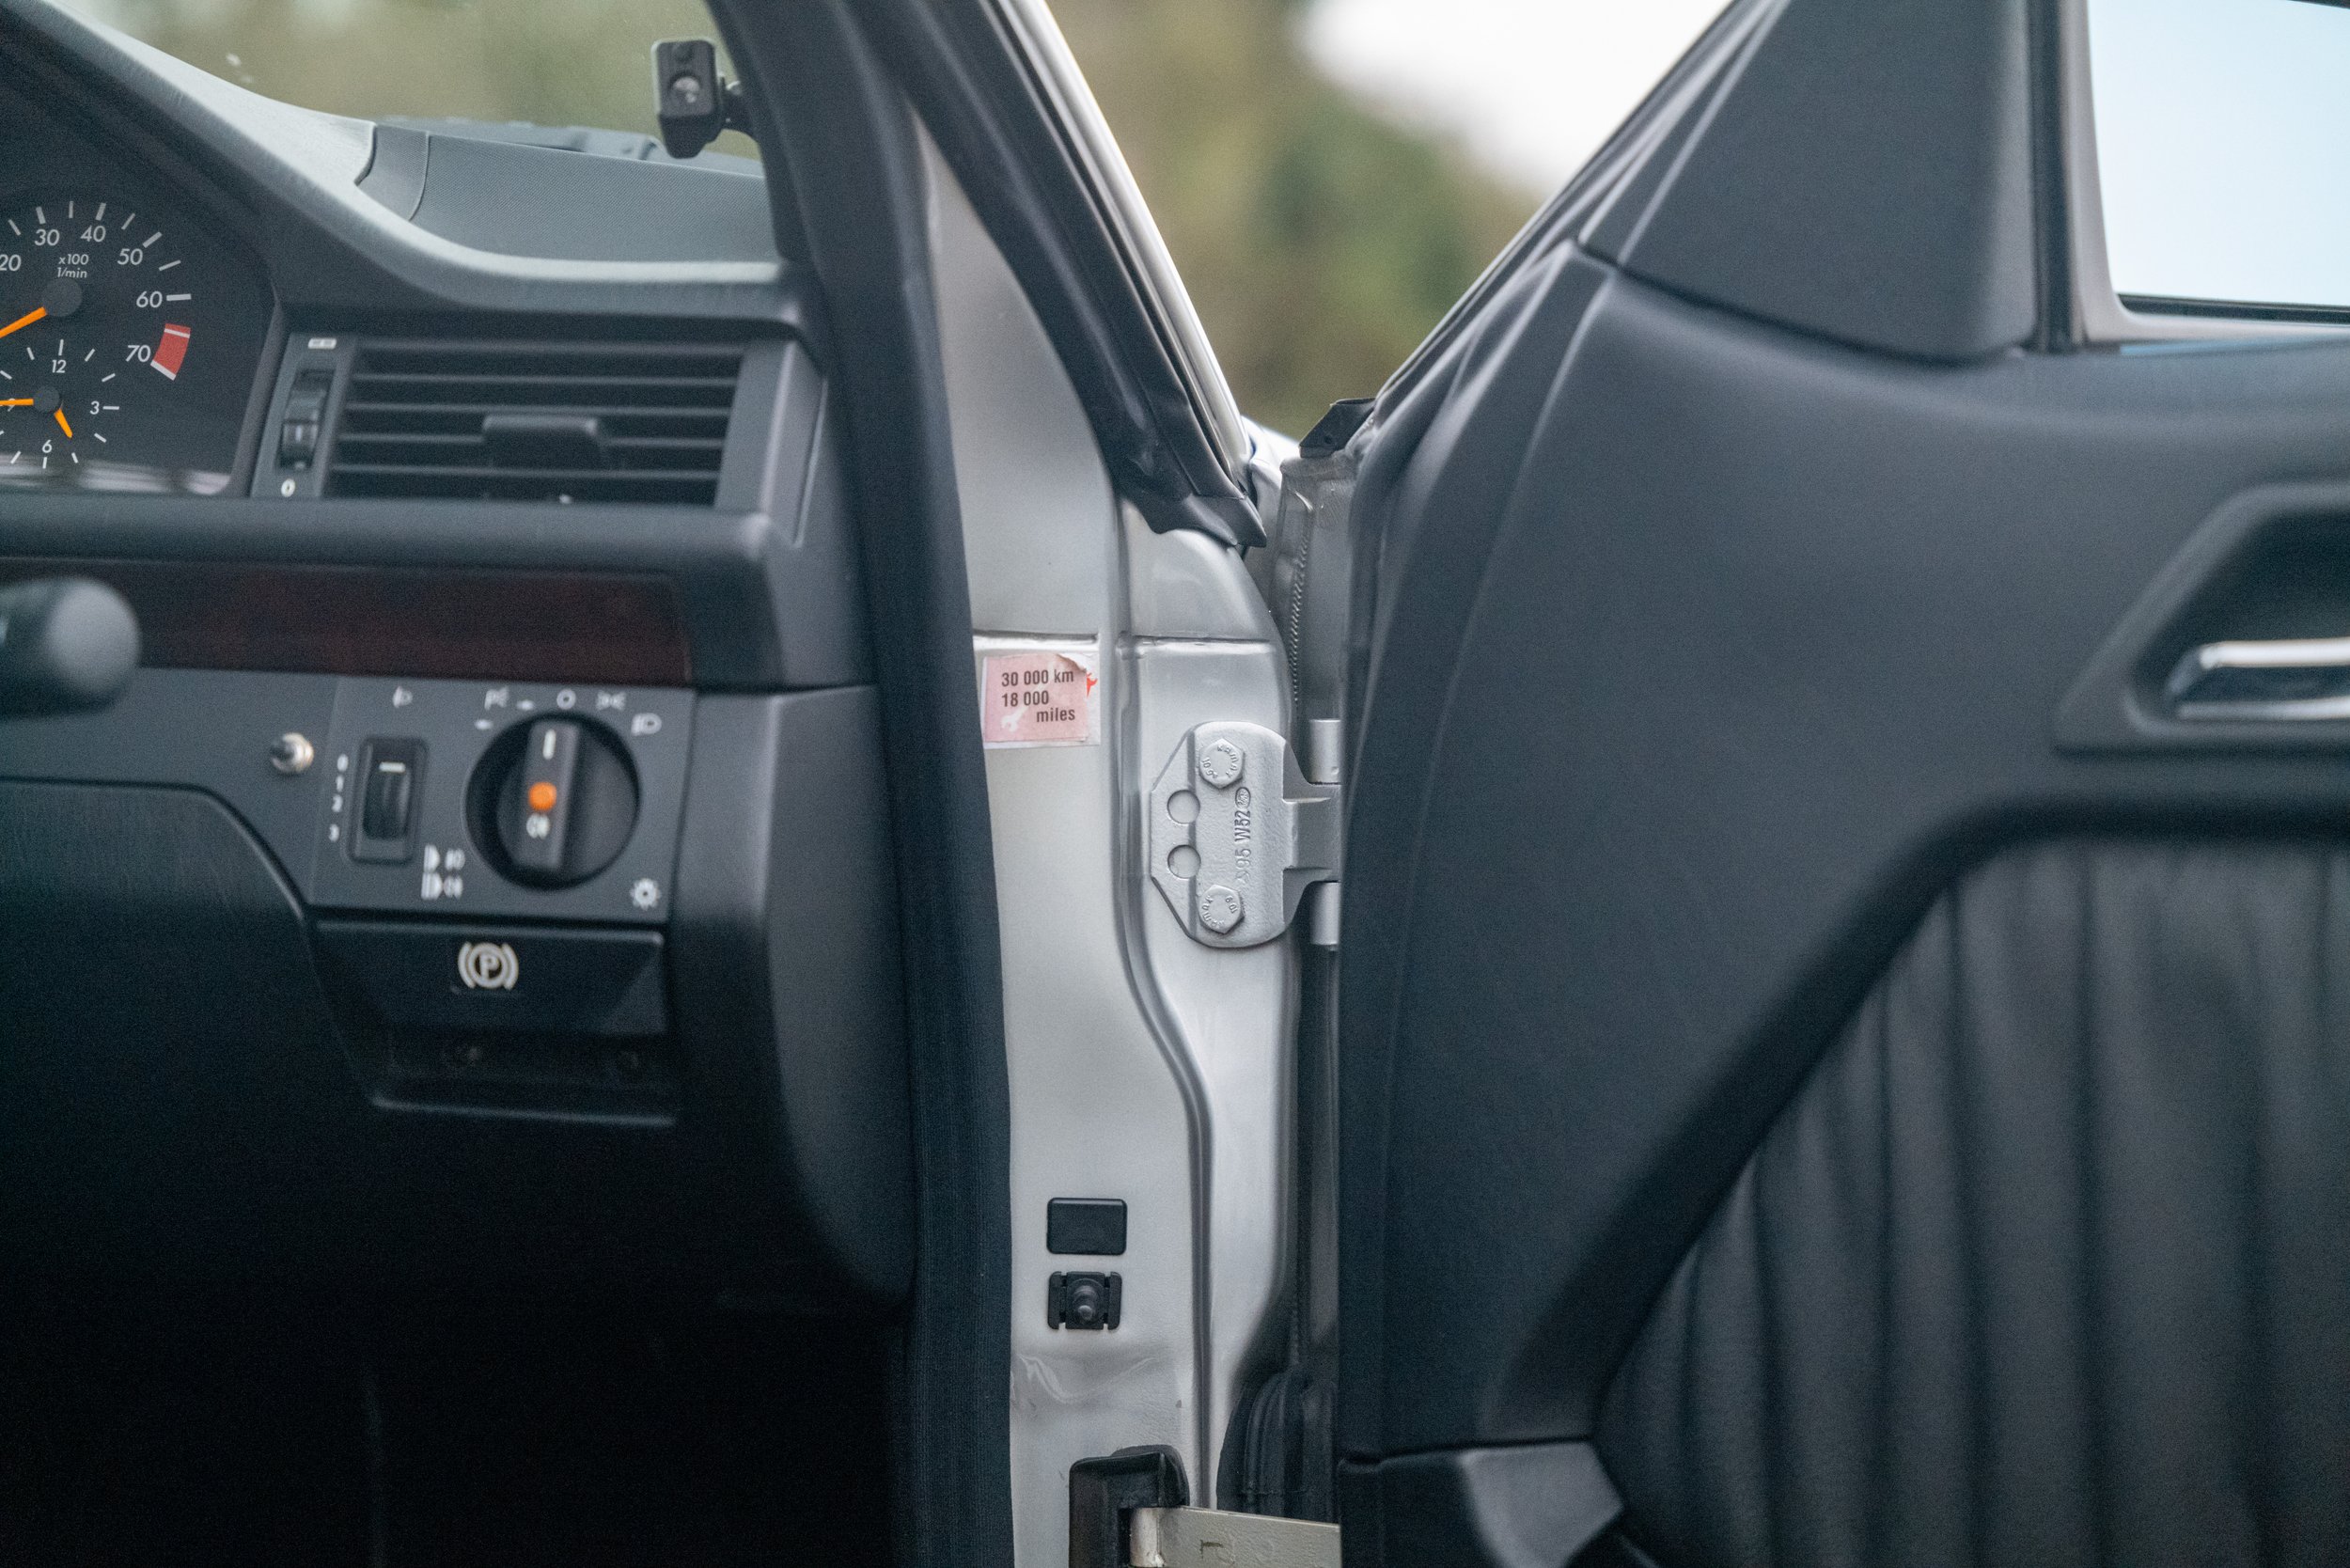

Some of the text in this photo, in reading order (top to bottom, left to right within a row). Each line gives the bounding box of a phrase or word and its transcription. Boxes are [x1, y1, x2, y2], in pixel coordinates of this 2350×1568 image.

[35, 228, 59, 246] 30
[81, 225, 106, 242] 40
[0, 254, 21, 271] 20
[58, 253, 89, 265] x100
[118, 248, 143, 265] 50
[57, 267, 87, 278] 1/min
[136, 290, 163, 308] 60
[126, 344, 151, 362] 70
[52, 360, 66, 373] 12
[89, 400, 100, 415] 3
[42, 439, 52, 453] 6
[1001, 669, 1074, 687] 30 000 km
[1002, 690, 1049, 707] 18 000
[1036, 707, 1075, 723] miles
